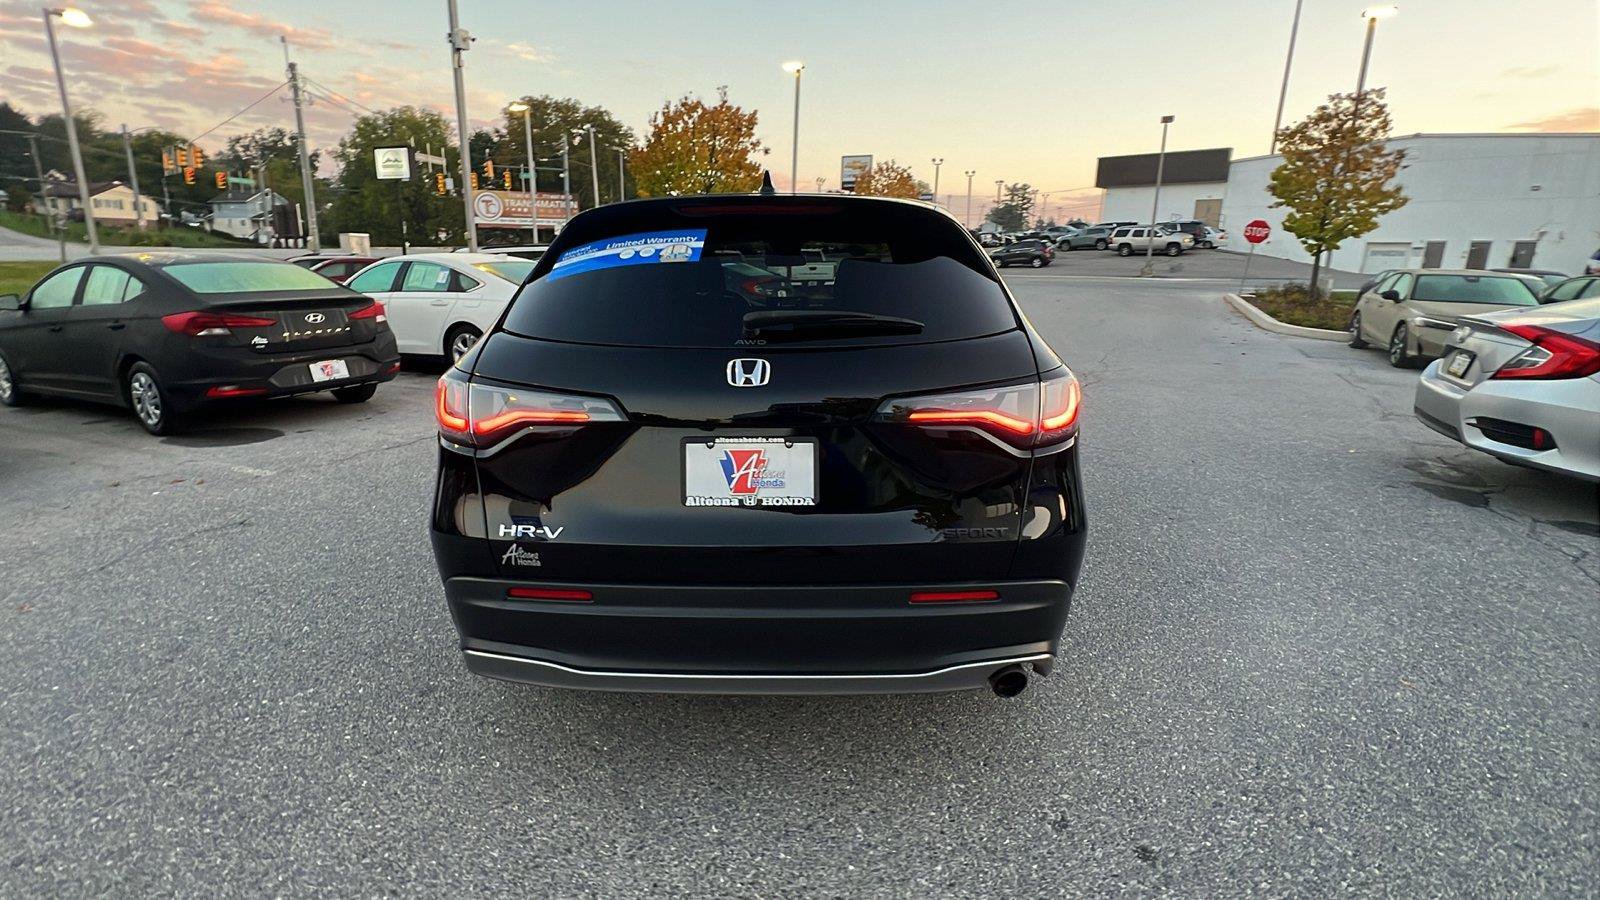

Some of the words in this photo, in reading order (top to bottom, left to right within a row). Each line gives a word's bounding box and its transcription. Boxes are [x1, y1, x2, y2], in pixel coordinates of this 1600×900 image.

[1244, 226, 1270, 237] STOP
[606, 238, 645, 250] Limited
[647, 235, 698, 244] Warranty
[752, 479, 785, 488] Honda
[686, 496, 739, 506] Altoona
[761, 497, 815, 506] HONDA
[499, 524, 564, 539] HR-V
[943, 527, 1009, 539] SPORT
